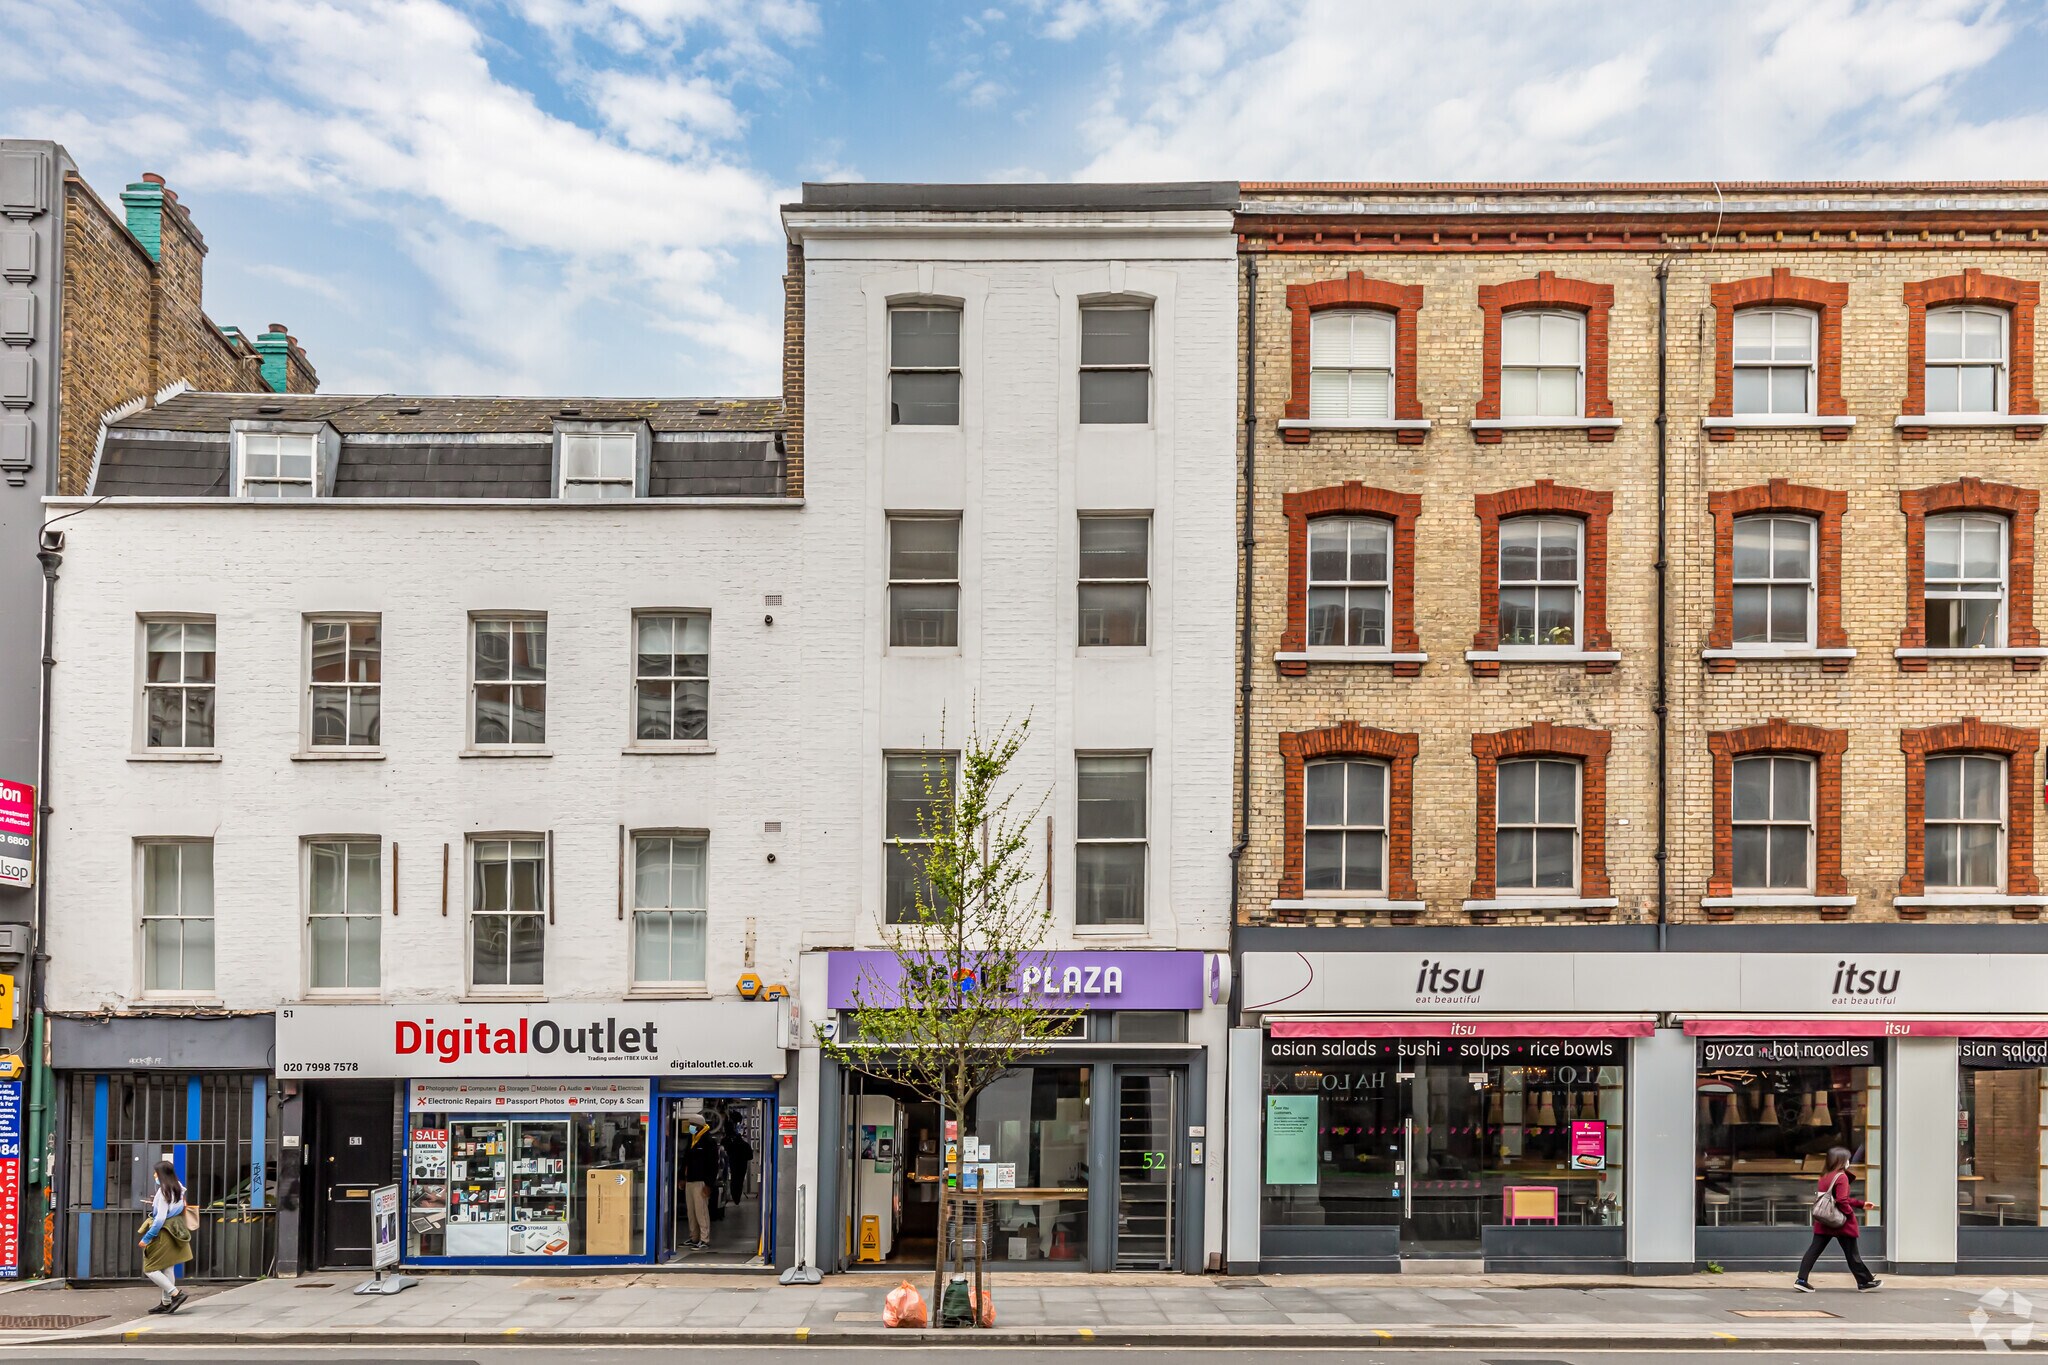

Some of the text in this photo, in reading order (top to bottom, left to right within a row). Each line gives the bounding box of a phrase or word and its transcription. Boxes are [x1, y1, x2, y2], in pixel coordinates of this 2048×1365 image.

[8, 836, 30, 847] 6800
[1022, 965, 1122, 994] PLAZA
[1416, 959, 1484, 994] itsu
[1832, 960, 1900, 995] itsu
[742, 981, 754, 989] ADT
[1416, 995, 1480, 1004] eat beautiful
[1832, 996, 1896, 1005] eat beautiful
[283, 1010, 294, 1018] 51
[1451, 1022, 1477, 1035] itsu
[1885, 1021, 1910, 1035] itsu
[1271, 1040, 1613, 1060] asian salads sushi soups rice bowls
[1705, 1043, 1754, 1060] gyoza
[1773, 1041, 1799, 1057] hot
[1804, 1041, 1869, 1057] noodles
[2002, 1041, 2047, 1057] salad
[283, 1062, 359, 1072] 020 7998 7578
[670, 1060, 754, 1070] digitaloutlet.co.uk
[416, 1130, 445, 1140] SALE
[1142, 1152, 1166, 1169] 52
